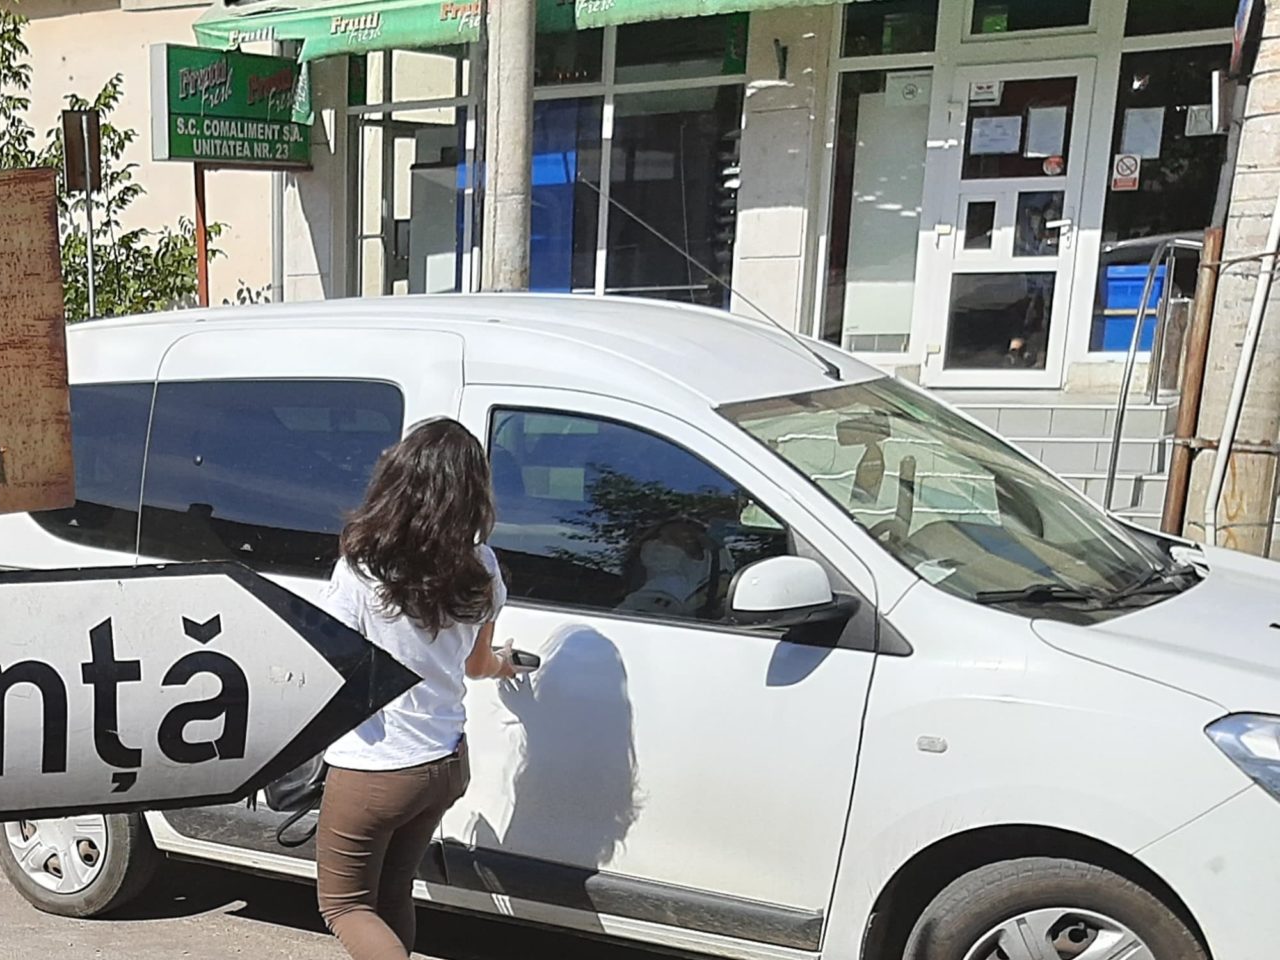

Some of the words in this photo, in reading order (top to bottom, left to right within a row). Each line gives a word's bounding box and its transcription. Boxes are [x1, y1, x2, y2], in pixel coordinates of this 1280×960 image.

[176, 117, 200, 135] S.C.
[203, 119, 280, 140] COMALIMENT
[193, 139, 252, 158] UNITATEA
[254, 142, 273, 159] NR.
[275, 143, 289, 159] 23
